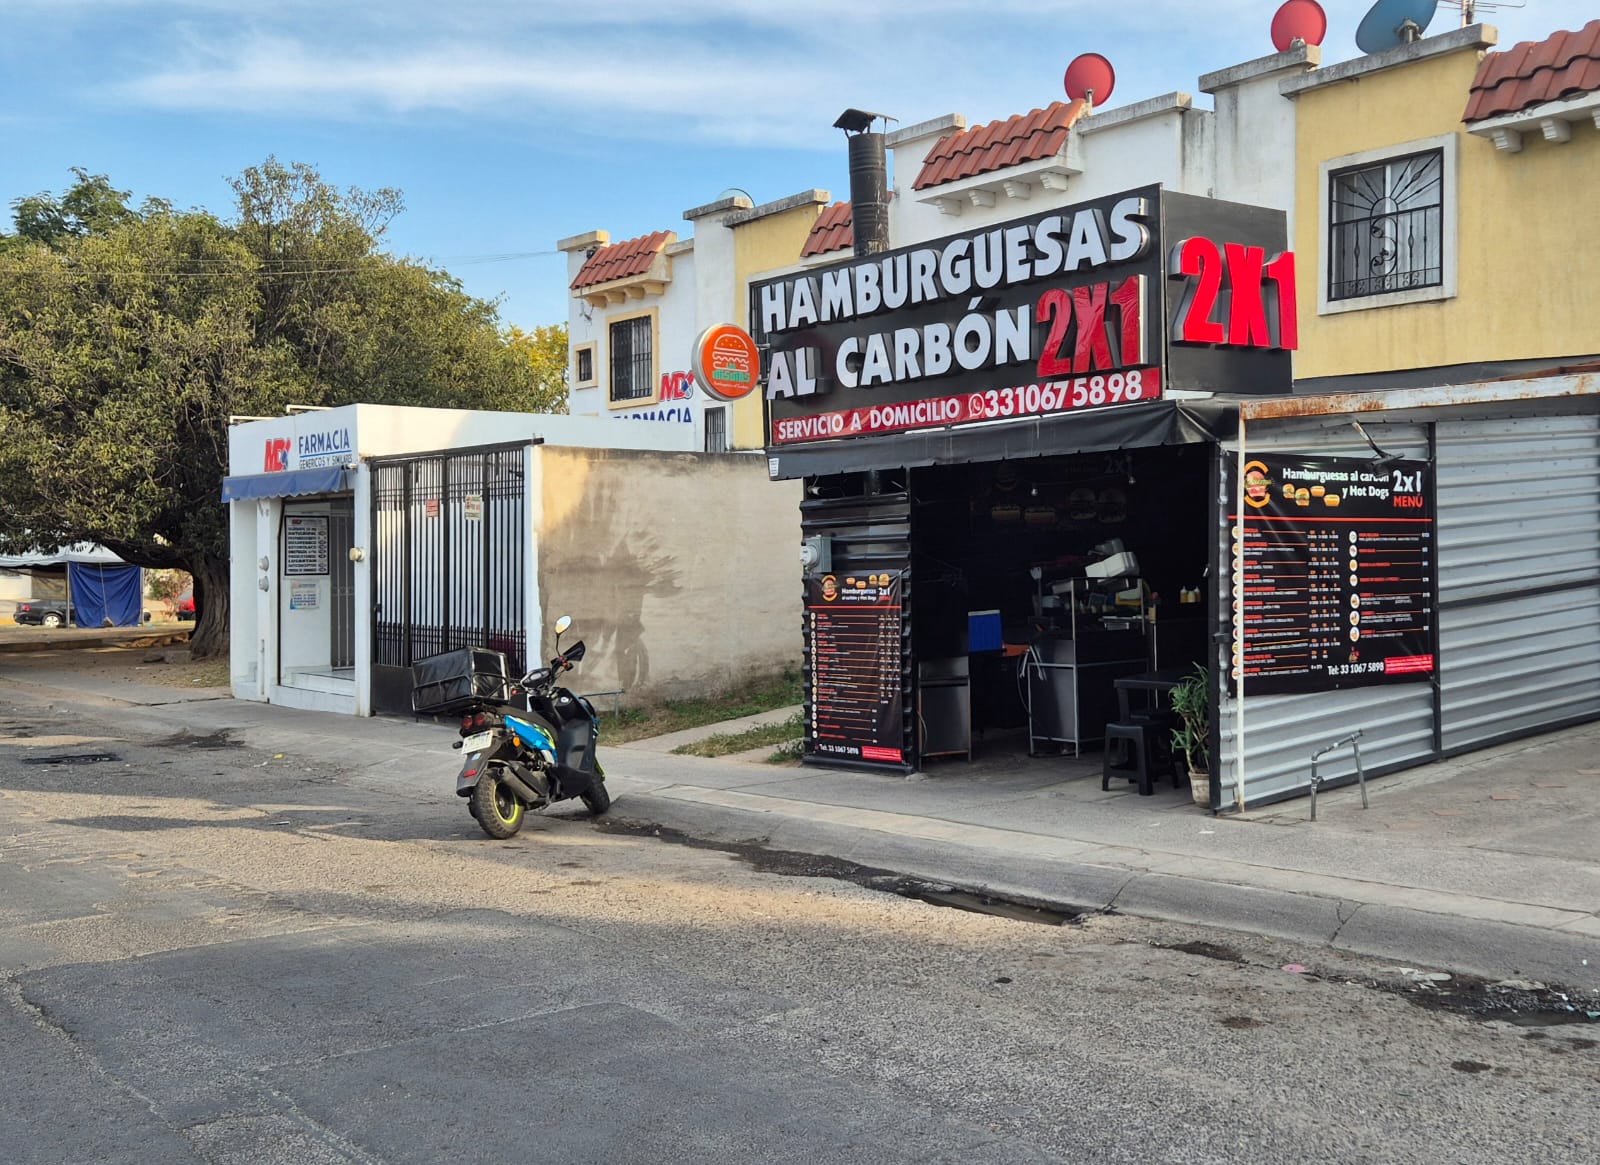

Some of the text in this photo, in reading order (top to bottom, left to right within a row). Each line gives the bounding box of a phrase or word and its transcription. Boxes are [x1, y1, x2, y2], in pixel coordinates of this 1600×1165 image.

[761, 197, 1150, 333] HAMBURGUESAS
[1174, 236, 1298, 351] 2X1
[766, 273, 1146, 400] AL CARBÓN 2X1
[778, 413, 844, 440] SERVICIO
[850, 413, 862, 431] A
[870, 398, 960, 427] DOMICILIO
[298, 428, 350, 454] FARMACIA
[1282, 467, 1349, 483] Hamburguesas
[1350, 470, 1359, 482] al
[1342, 485, 1389, 500] y Hot Dogs
[1350, 663, 1367, 674] 1067
